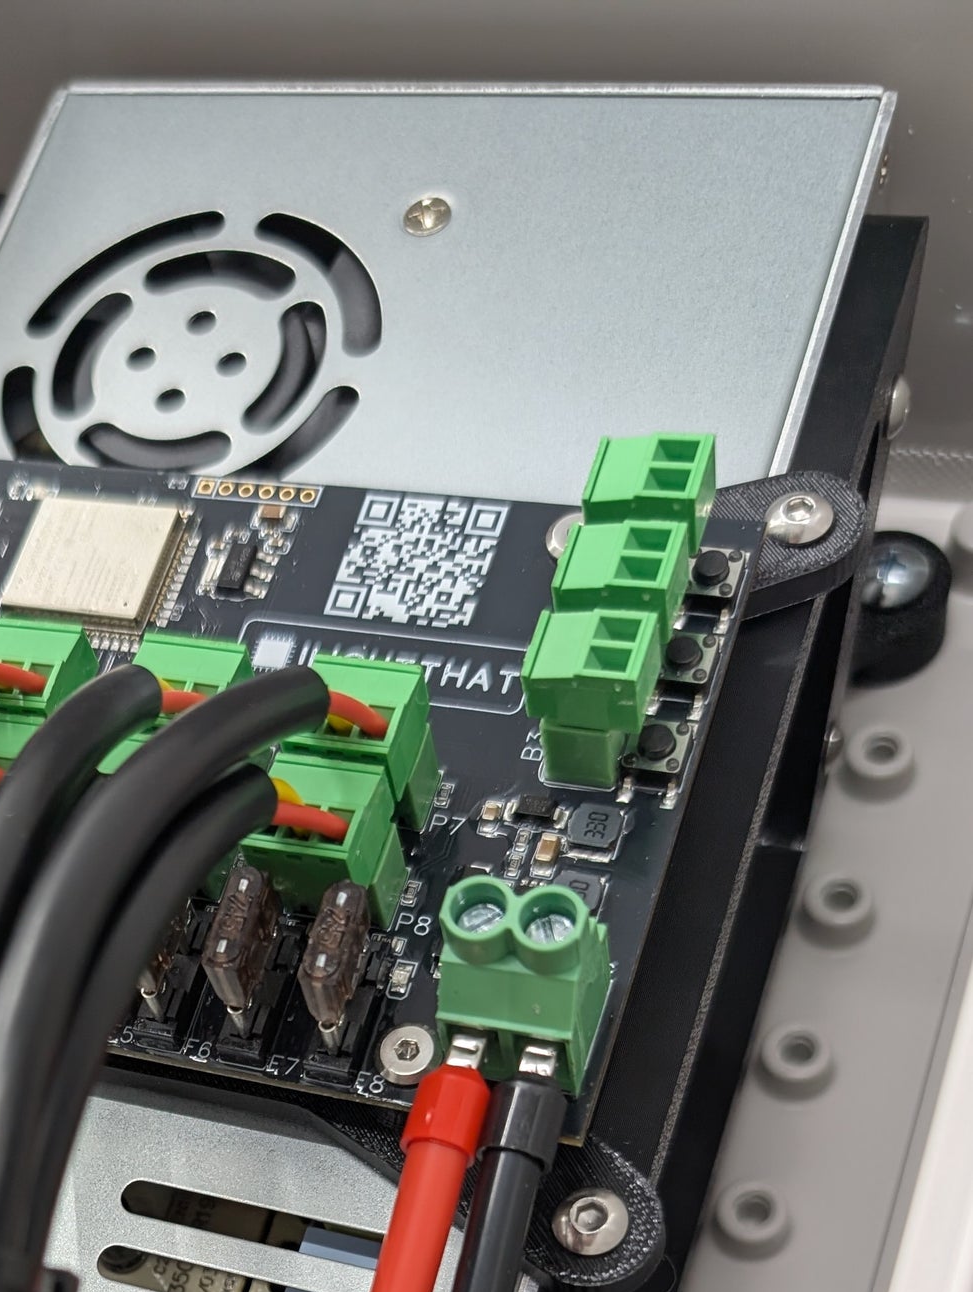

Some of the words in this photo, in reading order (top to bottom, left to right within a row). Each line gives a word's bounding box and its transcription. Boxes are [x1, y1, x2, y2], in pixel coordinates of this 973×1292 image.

[296, 640, 519, 695] ITHAT
[428, 813, 467, 836] P7
[583, 810, 609, 840] 330
[395, 912, 432, 937] P8
[183, 1038, 212, 1060] F6
